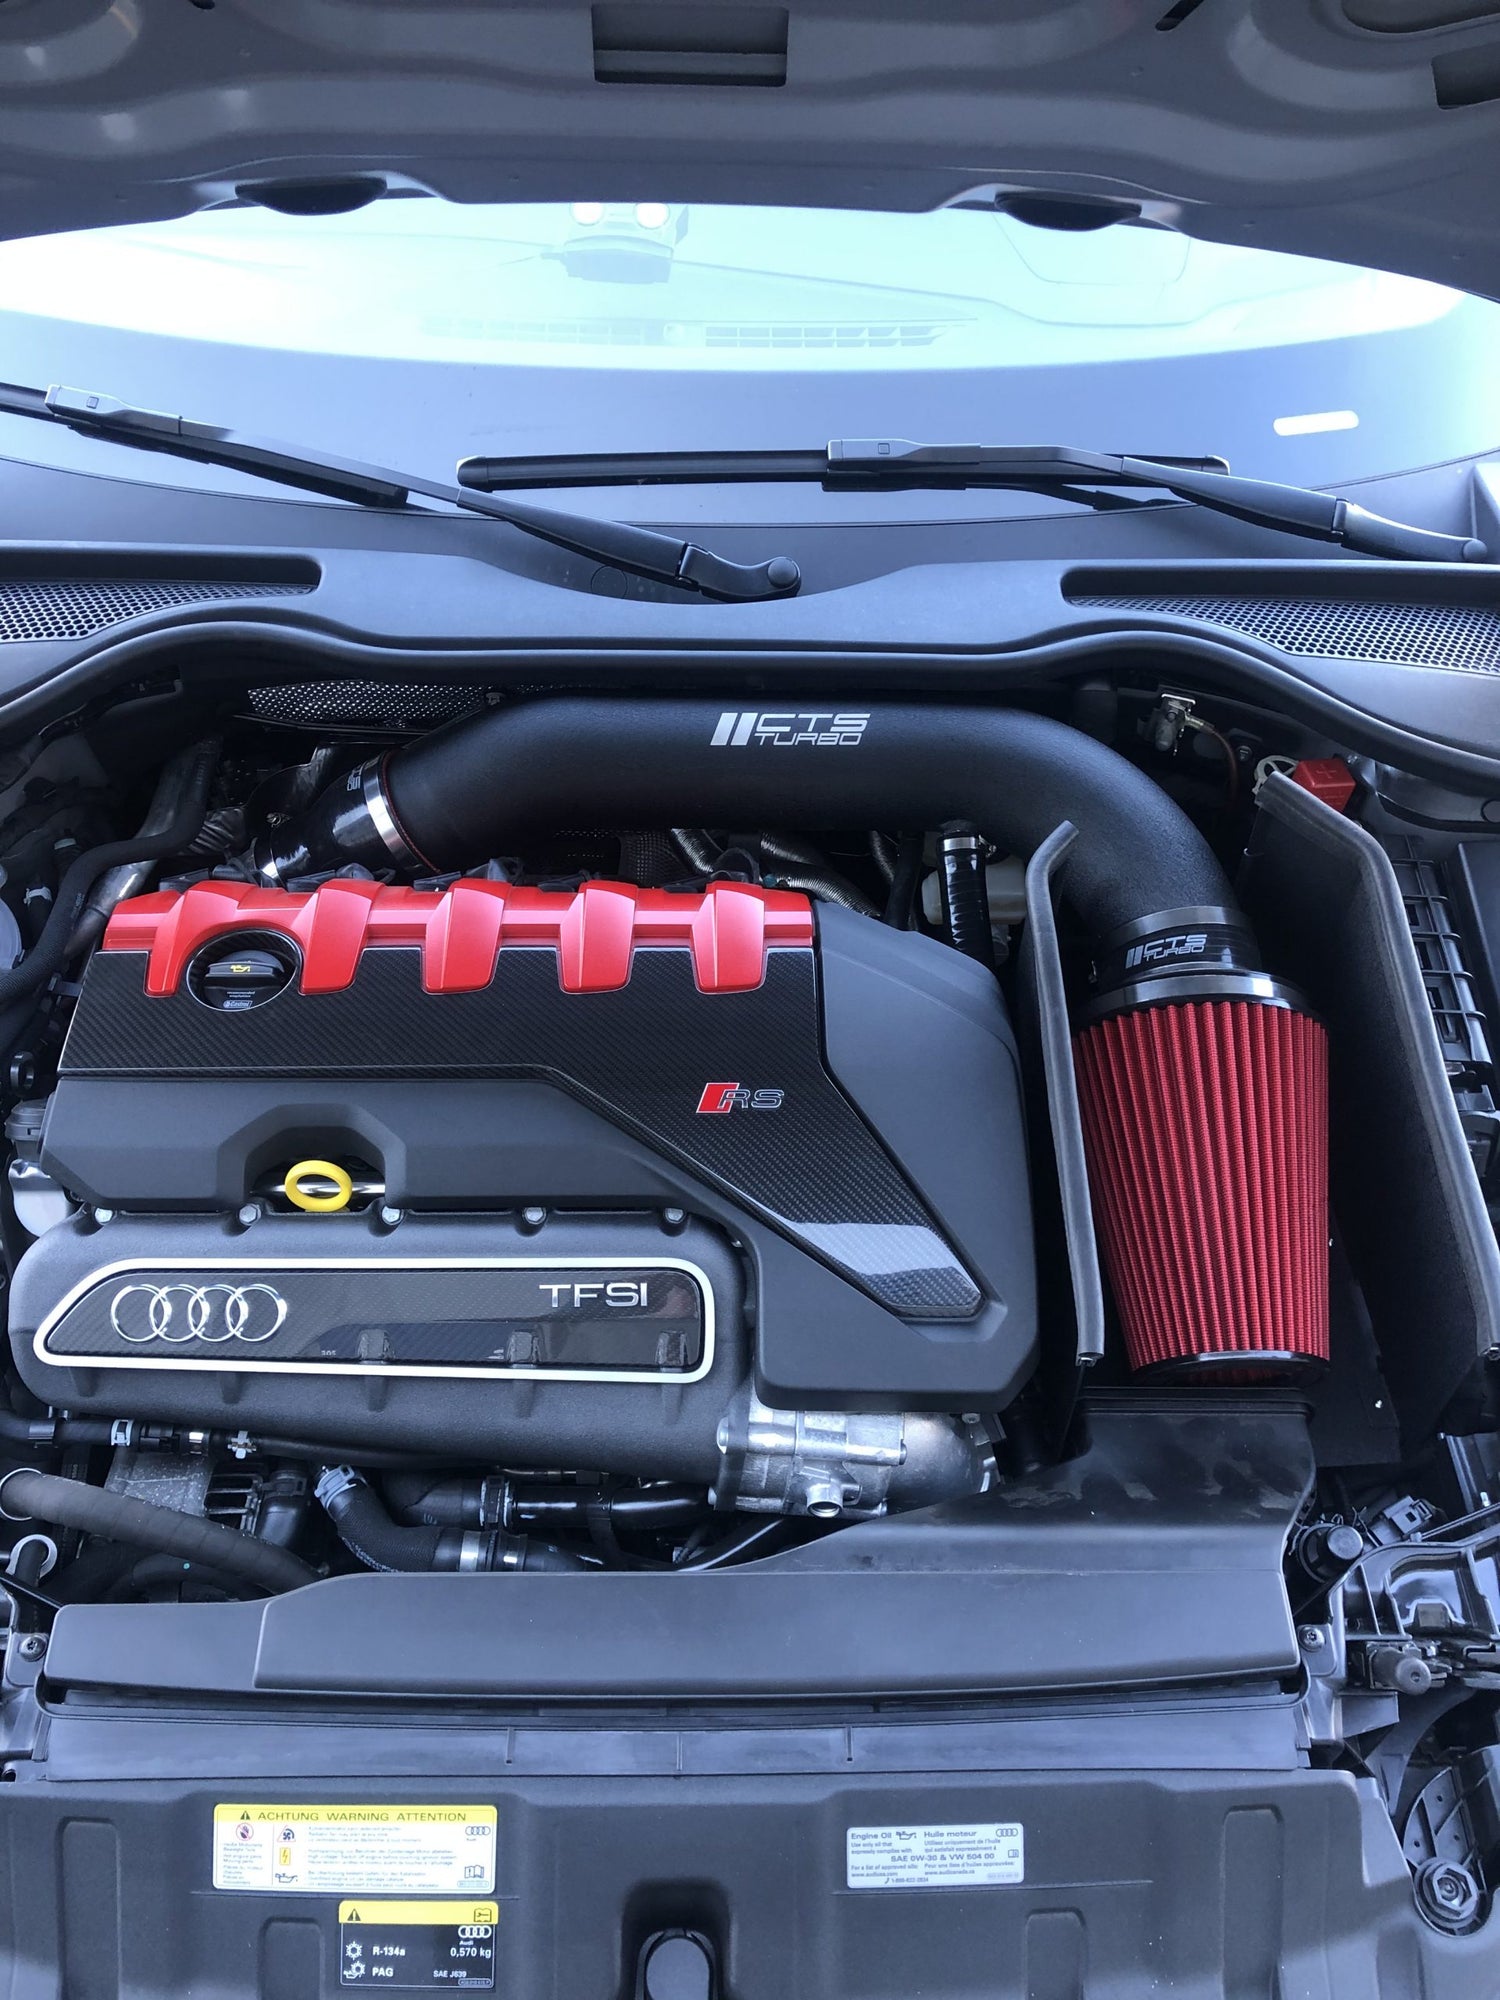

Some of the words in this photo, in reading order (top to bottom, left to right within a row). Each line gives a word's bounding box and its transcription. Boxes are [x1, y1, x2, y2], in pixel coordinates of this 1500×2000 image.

[756, 713, 872, 732] CTS
[754, 732, 862, 746] TURBO
[1143, 934, 1207, 955] CTS
[1143, 945, 1205, 961] TURBO
[713, 1087, 785, 1110] RS
[539, 1282, 648, 1308] TFSI
[258, 1812, 319, 1821] ACHTUNG
[327, 1812, 389, 1822] WARNING
[397, 1812, 467, 1822] ATTENTION
[851, 1832, 879, 1841] Engine
[910, 1854, 938, 1862] 0W-30
[372, 1945, 406, 1957] R-134a
[450, 1947, 478, 1958] 0,570
[479, 1947, 492, 1959] kg
[372, 1967, 394, 1977] PAG
[433, 1970, 448, 1978] SAE
